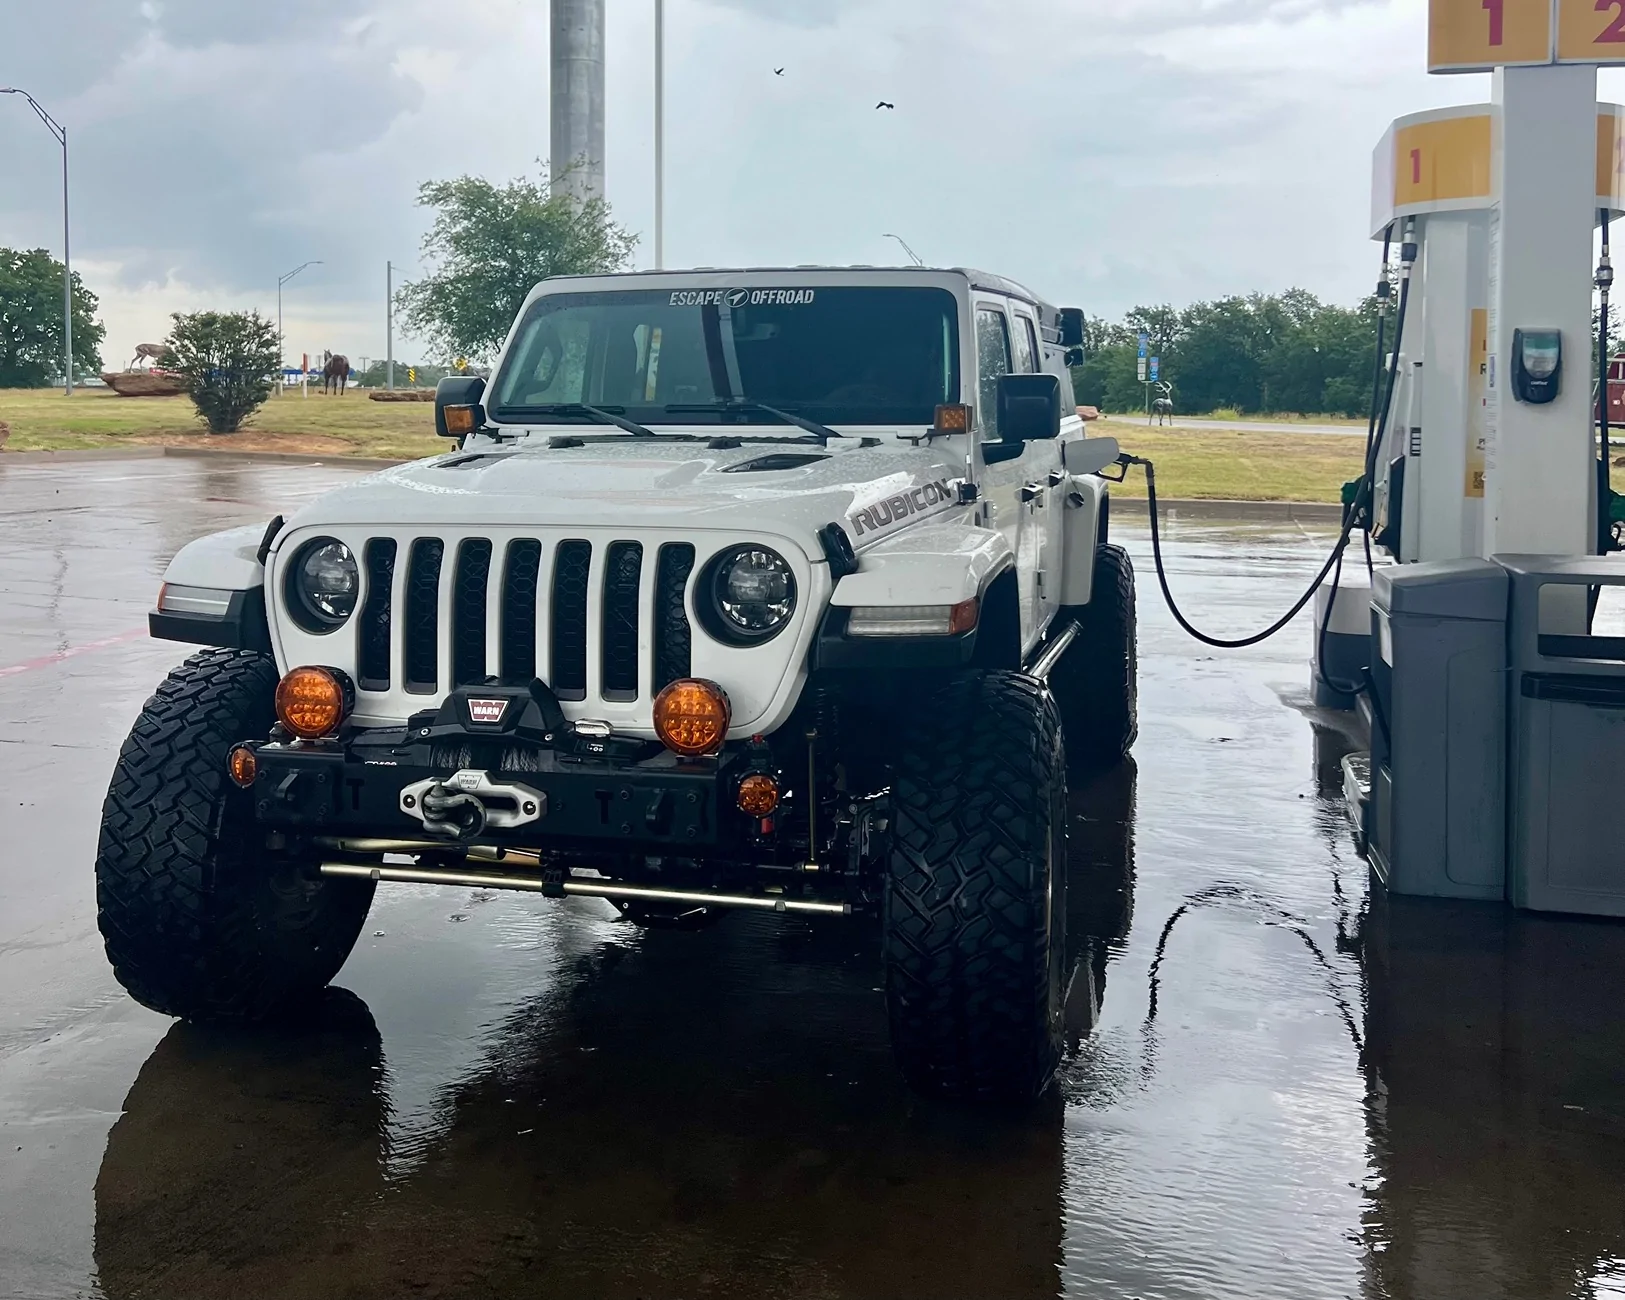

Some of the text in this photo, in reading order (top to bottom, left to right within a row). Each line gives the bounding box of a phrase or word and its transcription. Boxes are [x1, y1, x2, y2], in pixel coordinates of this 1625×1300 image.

[1481, 0, 1503, 46] 1
[1592, 0, 1625, 43] 2
[1410, 148, 1420, 184] 1
[669, 289, 815, 306] ESCAPE OFFROAD
[850, 477, 952, 537] RUBICON
[473, 706, 500, 716] WARN
